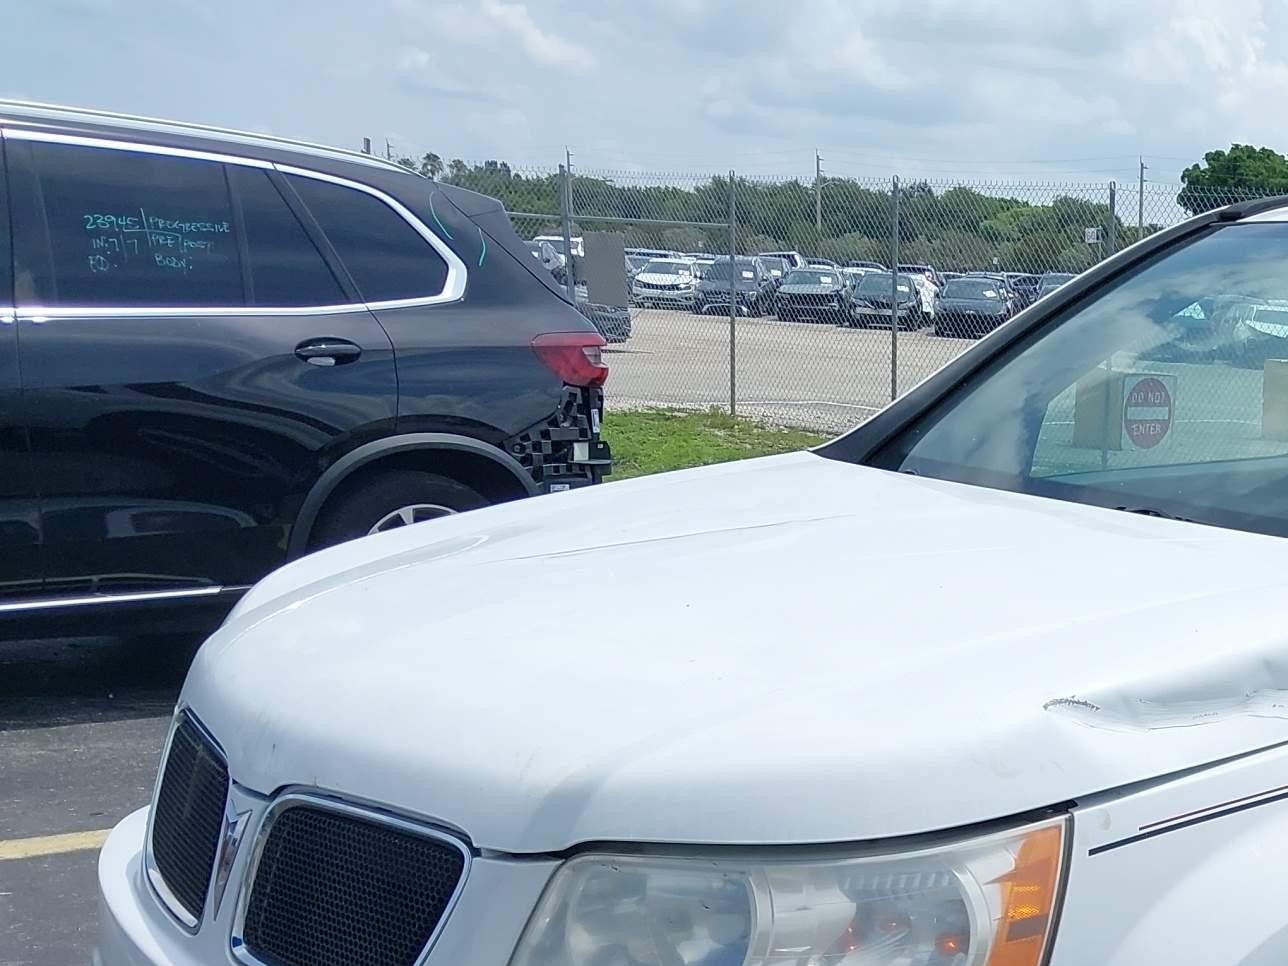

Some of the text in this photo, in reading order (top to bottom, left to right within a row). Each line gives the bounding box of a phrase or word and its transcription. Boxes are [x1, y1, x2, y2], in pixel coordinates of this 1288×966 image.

[1131, 391, 1166, 403] DO NOT
[1131, 423, 1162, 435] ENTER
